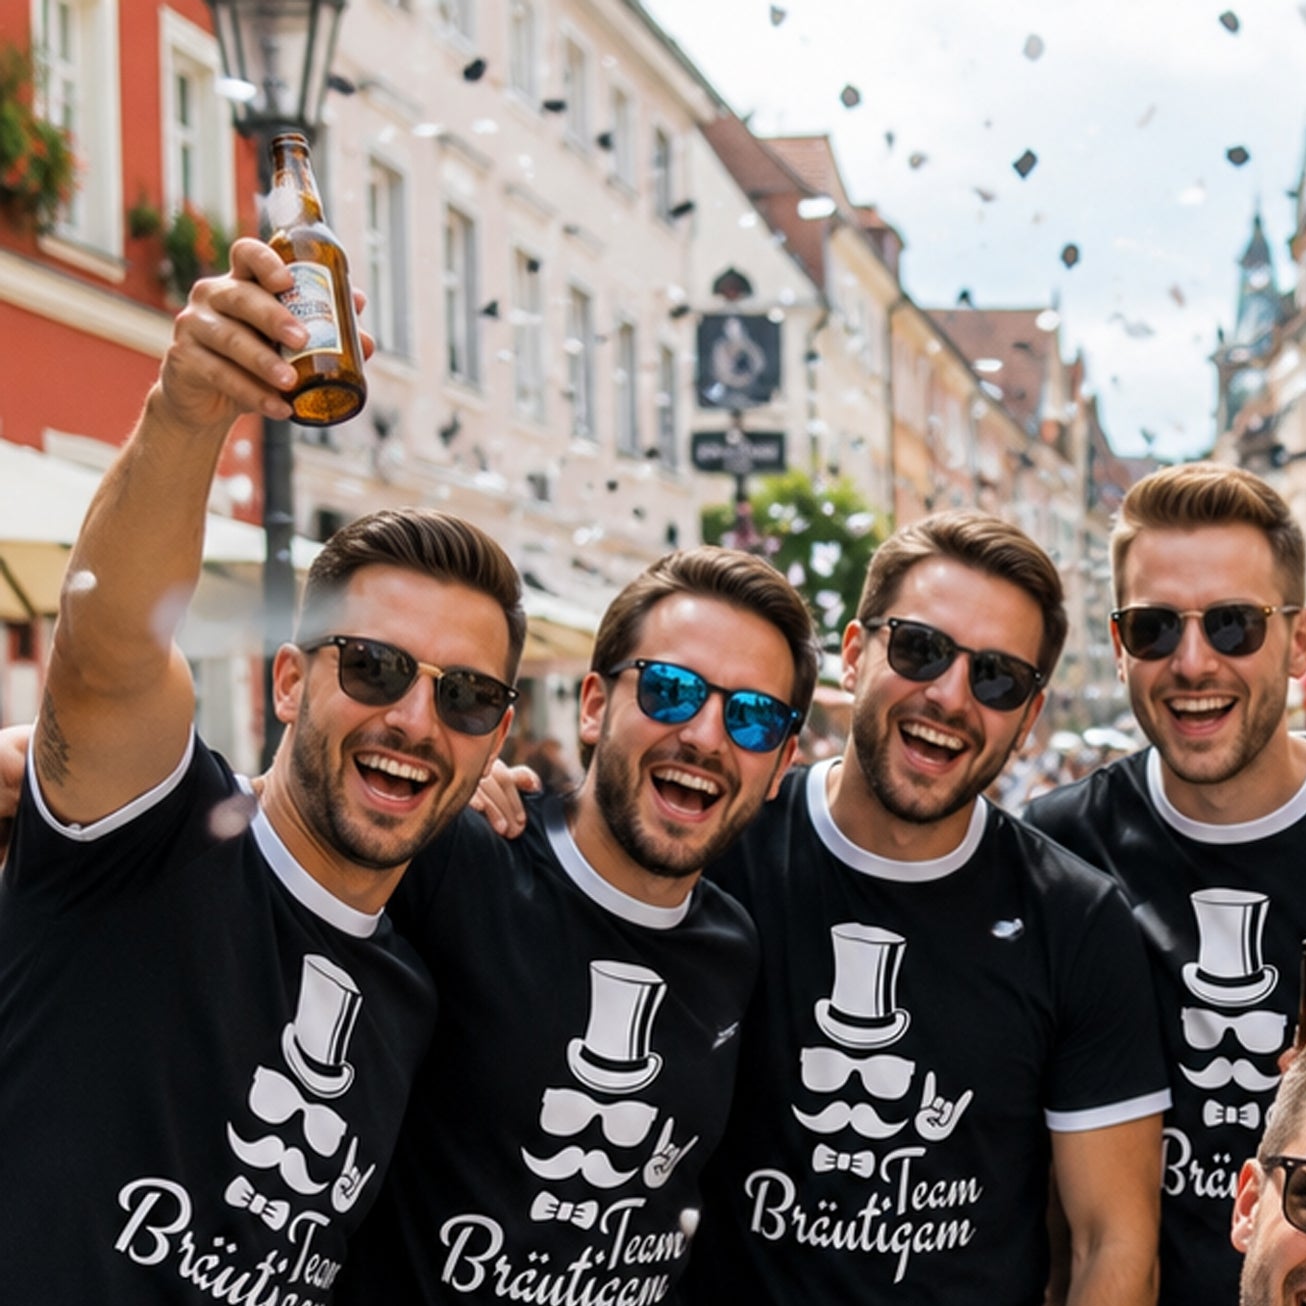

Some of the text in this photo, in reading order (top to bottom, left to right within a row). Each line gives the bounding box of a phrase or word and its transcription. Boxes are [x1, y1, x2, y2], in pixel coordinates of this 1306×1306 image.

[879, 1146, 983, 1216] Team
[599, 1197, 686, 1271] Team
[744, 1168, 976, 1284] Bräutigam
